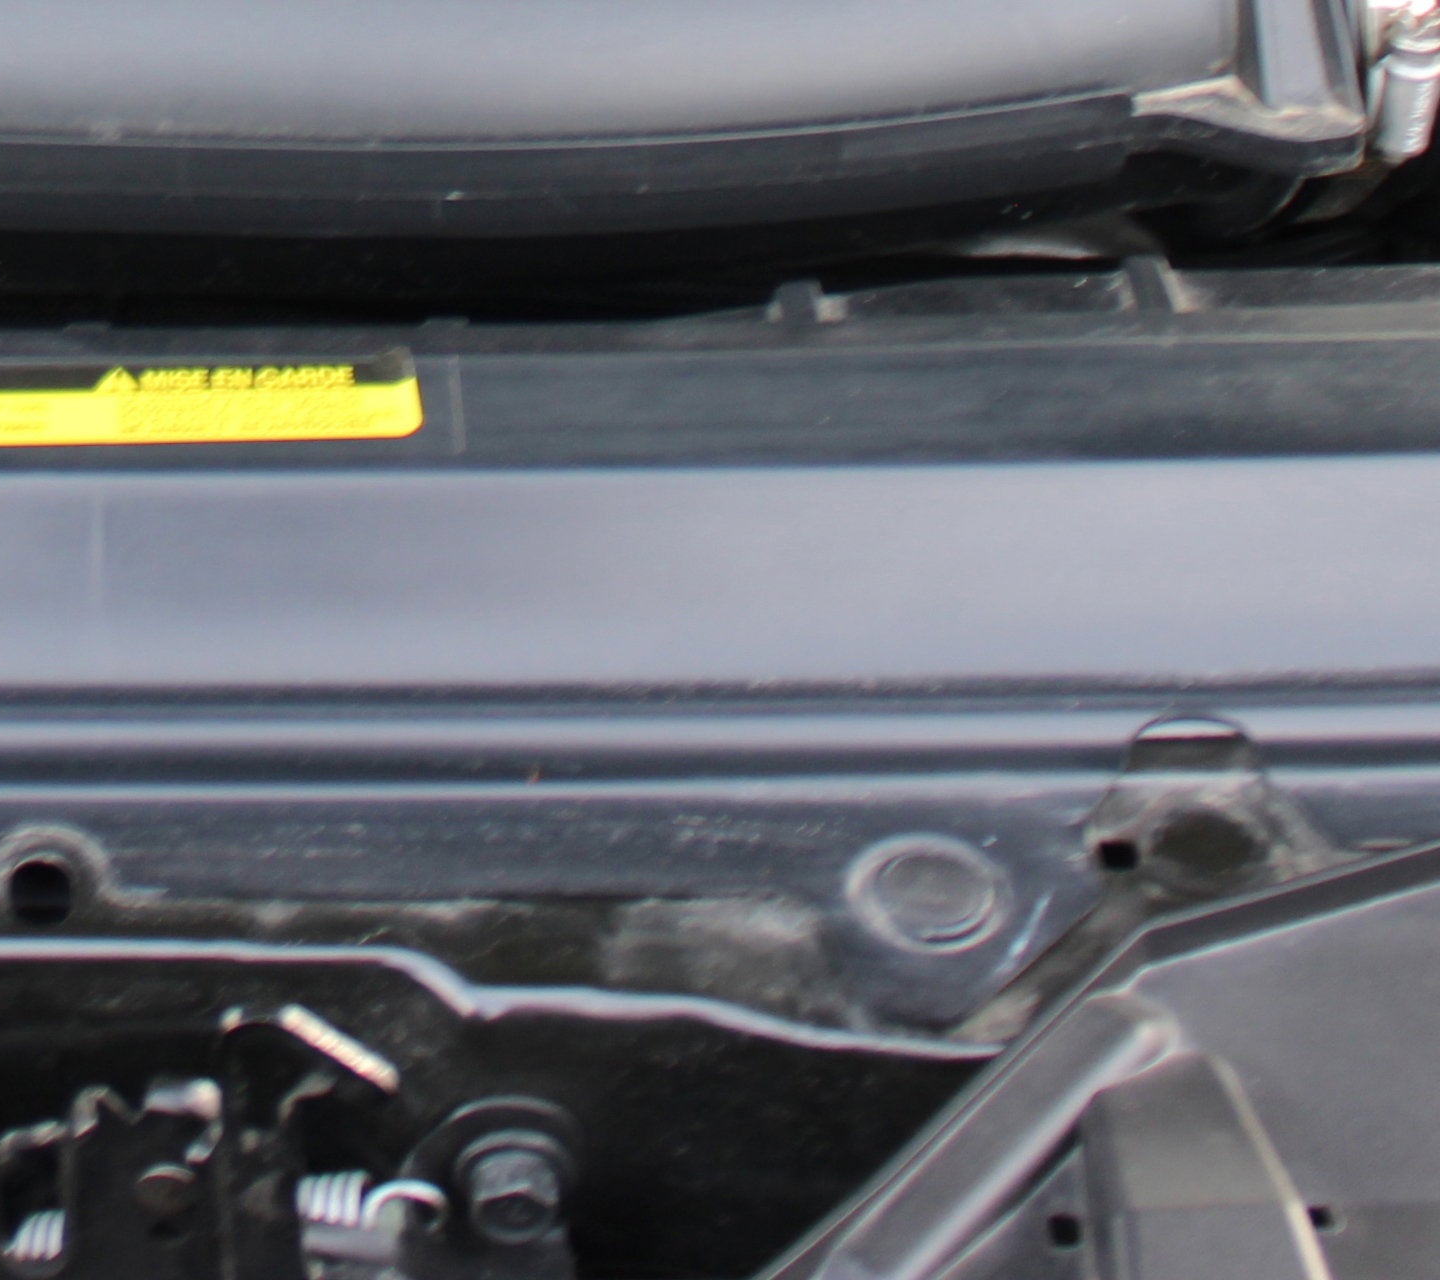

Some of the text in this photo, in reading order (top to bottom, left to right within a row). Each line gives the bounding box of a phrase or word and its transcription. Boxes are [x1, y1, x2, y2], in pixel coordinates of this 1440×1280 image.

[138, 366, 355, 392] MISE EN GARDE
